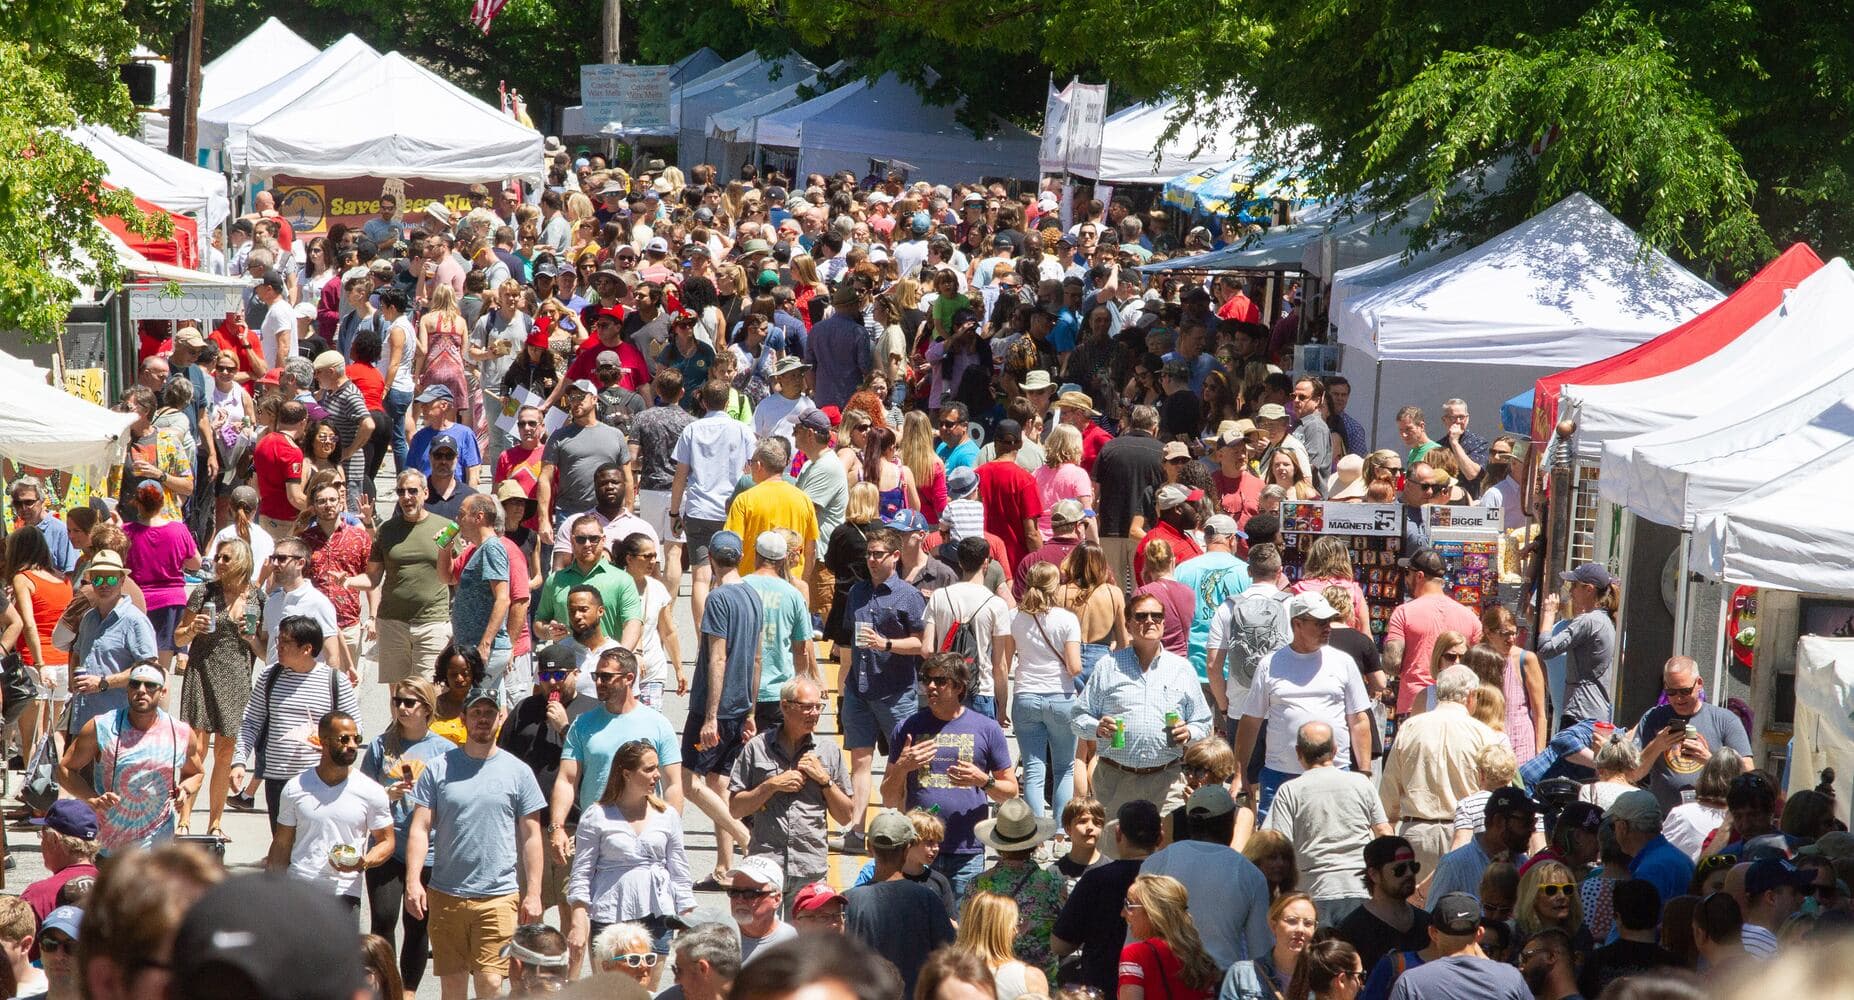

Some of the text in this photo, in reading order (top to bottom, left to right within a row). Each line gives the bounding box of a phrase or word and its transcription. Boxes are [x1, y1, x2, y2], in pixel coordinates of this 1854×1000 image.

[330, 197, 381, 216] Save
[131, 293, 216, 313] SPOON
[1328, 510, 1396, 531] MAGNETS $5
[1451, 517, 1483, 526] BIGGIE
[744, 857, 768, 869] ACH
